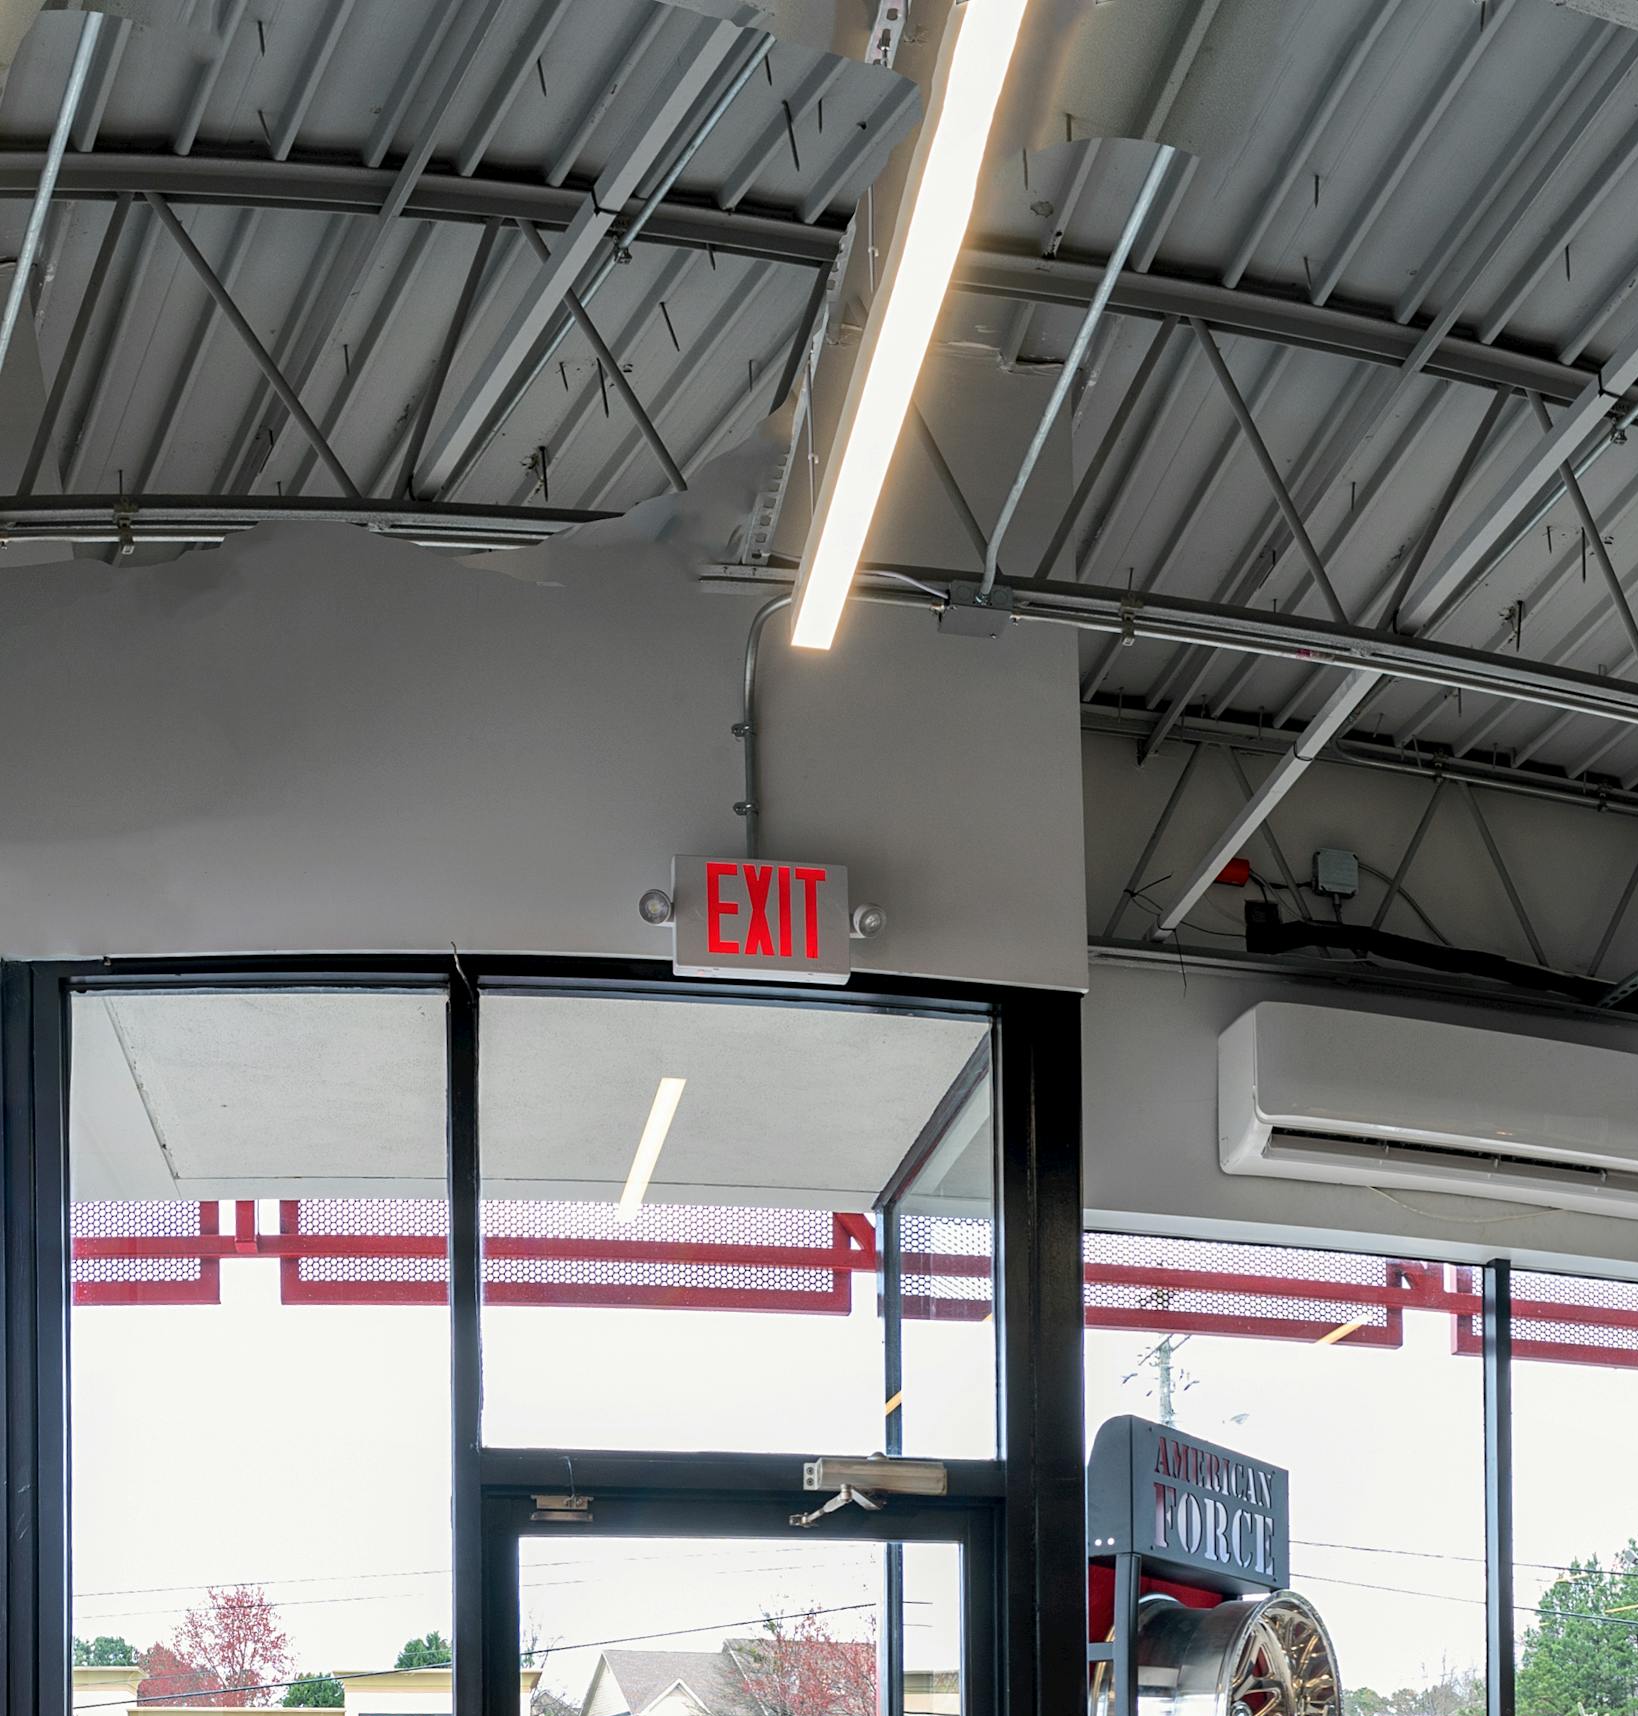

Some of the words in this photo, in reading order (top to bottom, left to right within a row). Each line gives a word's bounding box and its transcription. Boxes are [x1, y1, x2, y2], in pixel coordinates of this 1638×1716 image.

[706, 862, 827, 960] EXIT
[1154, 1436, 1274, 1509] AMERICAN
[1153, 1482, 1275, 1577] FORCE
